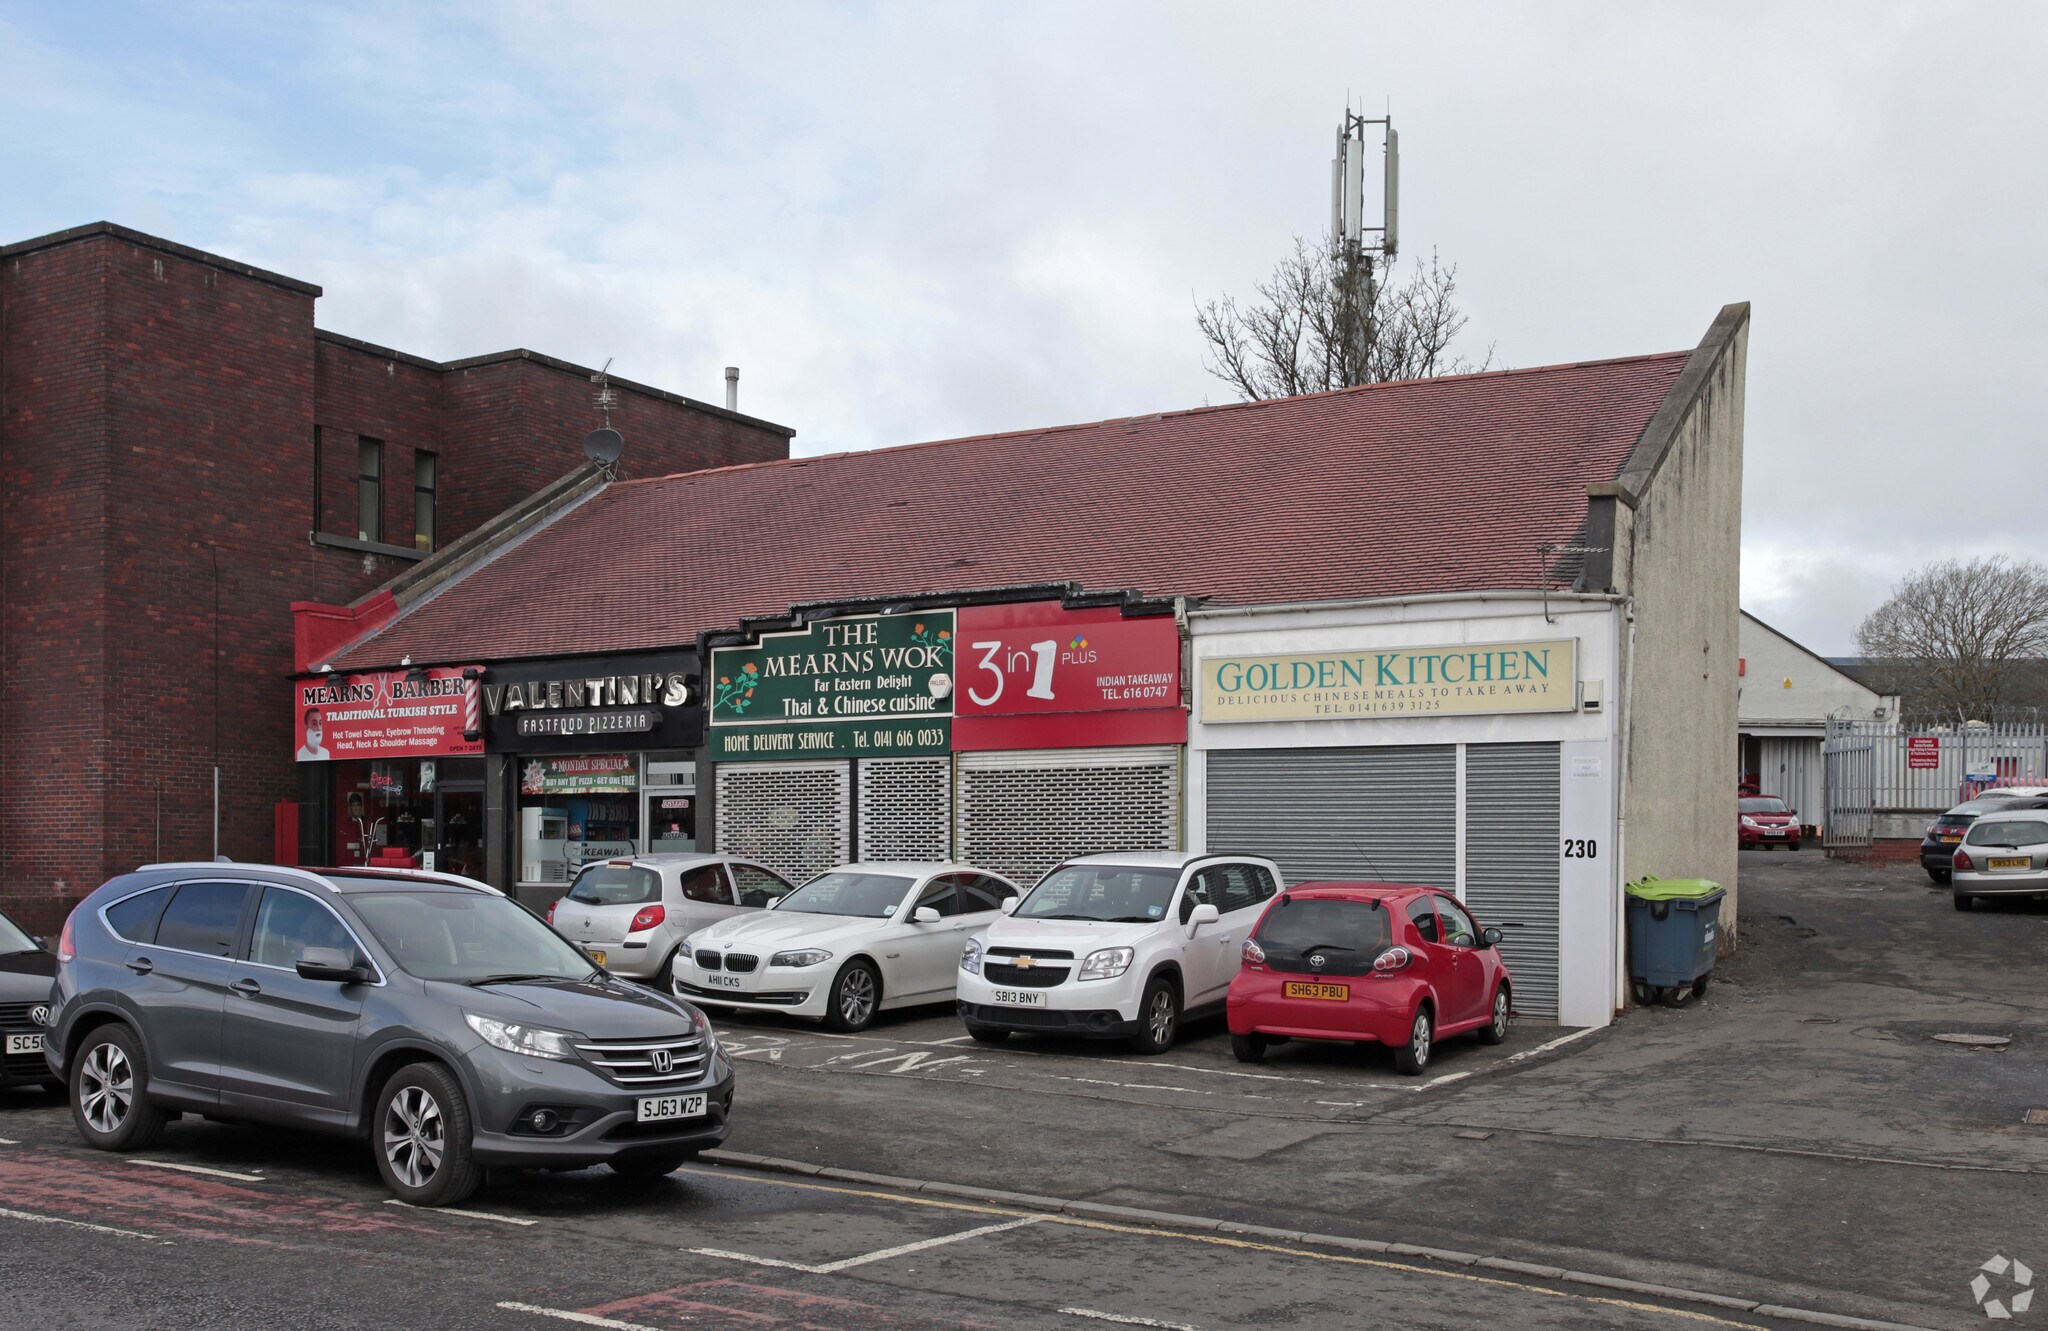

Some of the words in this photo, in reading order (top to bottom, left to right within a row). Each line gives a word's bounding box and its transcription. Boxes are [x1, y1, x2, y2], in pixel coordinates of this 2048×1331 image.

[822, 621, 878, 646] THE
[763, 650, 874, 677] MEARNS
[880, 645, 943, 669] WOK
[1061, 651, 1097, 664] PLUS
[968, 641, 1004, 706] 3
[1007, 646, 1029, 673] in
[1026, 640, 1057, 700] 1
[1216, 660, 1365, 692] GOLDEN
[1374, 649, 1550, 686] KITCHEN
[815, 678, 830, 692] Far
[834, 677, 871, 691] Eastern
[877, 674, 912, 689] Delight
[1097, 675, 1125, 687] INDIAN
[1128, 673, 1173, 685] TAKEAWAY
[303, 683, 374, 706] MEARNS
[392, 677, 465, 700] BARBER
[482, 672, 688, 716] VALENTINI'S
[1103, 688, 1121, 699] TEL.
[1124, 687, 1141, 698] 616
[1144, 686, 1168, 697] 0747
[1218, 694, 1297, 705] DELICIOUS
[1303, 690, 1369, 702] CHINESE
[1375, 689, 1424, 699] MEALS
[1432, 688, 1449, 697] TO
[1456, 685, 1496, 696] TAKE
[326, 708, 386, 722] TRADITIONAL
[387, 706, 427, 718] TURKISH
[429, 704, 457, 716] STYLE
[783, 698, 812, 717] Thai
[818, 697, 829, 715] &
[834, 695, 886, 715] Chinese
[890, 693, 936, 712] cuisine
[1315, 704, 1343, 714] TEL:
[1410, 700, 1440, 710] 3125
[332, 731, 343, 739] Hot
[345, 730, 362, 739] Towel
[364, 729, 385, 738] Shave,
[386, 727, 411, 738] Eyebrow
[413, 725, 445, 736] Threading
[523, 716, 583, 732] FASTFOOD
[589, 714, 646, 731] PIZZERIA
[336, 741, 355, 750] Head,
[356, 740, 372, 748] Neck
[373, 739, 378, 747] &
[380, 738, 407, 748] Shoulder
[409, 736, 438, 747] Massage
[724, 735, 750, 752] HOME
[753, 733, 794, 751] DELIVERY
[798, 732, 834, 750] SERVICE
[853, 730, 870, 748] Tel.
[873, 731, 892, 747] 0141
[896, 729, 914, 746] 616
[917, 729, 944, 746] 0033
[558, 759, 588, 773] MONDAY
[591, 758, 623, 771] SPECIAL
[546, 779, 557, 787] BUY
[558, 778, 568, 786] ANY
[579, 776, 593, 785] PIZZA
[597, 777, 608, 785] GET
[609, 776, 620, 785] ONE
[621, 775, 636, 786] FREE
[1564, 838, 1597, 859] 230
[723, 976, 740, 988] CKS
[1291, 984, 1319, 996] SH63
[1321, 986, 1343, 998] PBU
[995, 990, 1017, 1003] SB13
[1019, 992, 1039, 1004] BNY
[644, 1099, 677, 1117] SJ63
[680, 1096, 702, 1114] WZP
